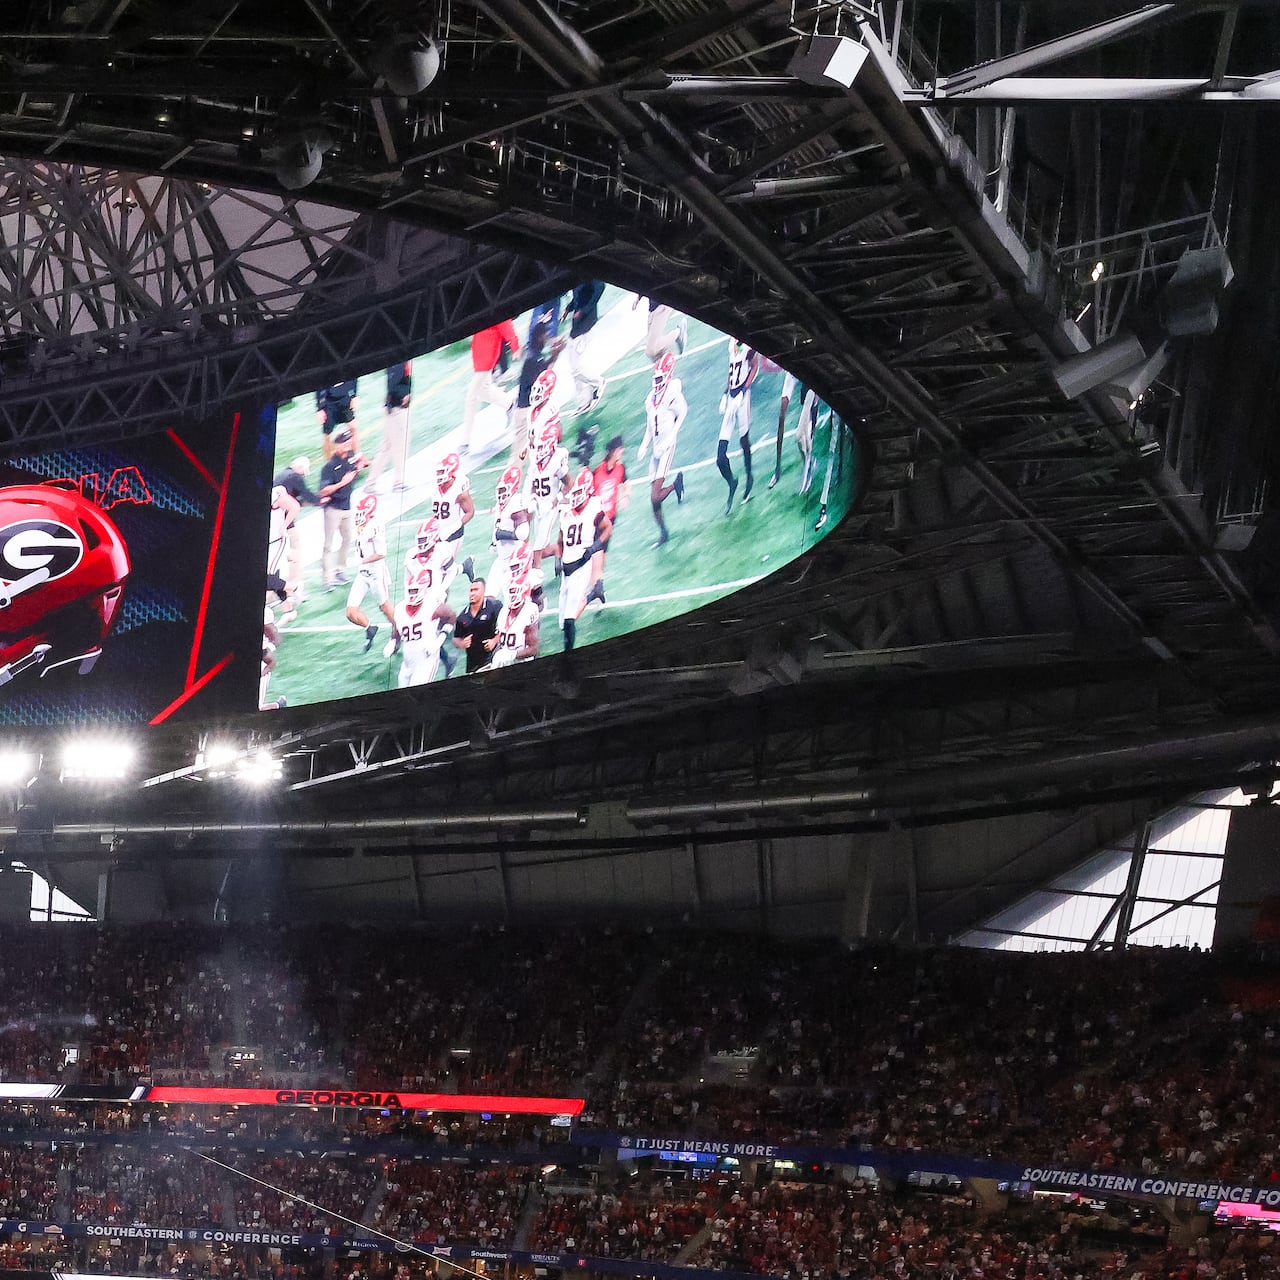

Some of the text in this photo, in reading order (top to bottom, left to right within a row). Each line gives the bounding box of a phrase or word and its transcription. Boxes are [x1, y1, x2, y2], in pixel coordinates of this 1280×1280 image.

[277, 1091, 401, 1107] GEORGIA
[636, 1138, 647, 1149] IT
[649, 1139, 680, 1151] JUST
[683, 1140, 729, 1154] MEANS
[1021, 1168, 1138, 1192] SOUTHEASTERN
[1141, 1179, 1253, 1203] CONFERENCE
[86, 1226, 300, 1245] SOUTHEASTERN CONFERENCE
